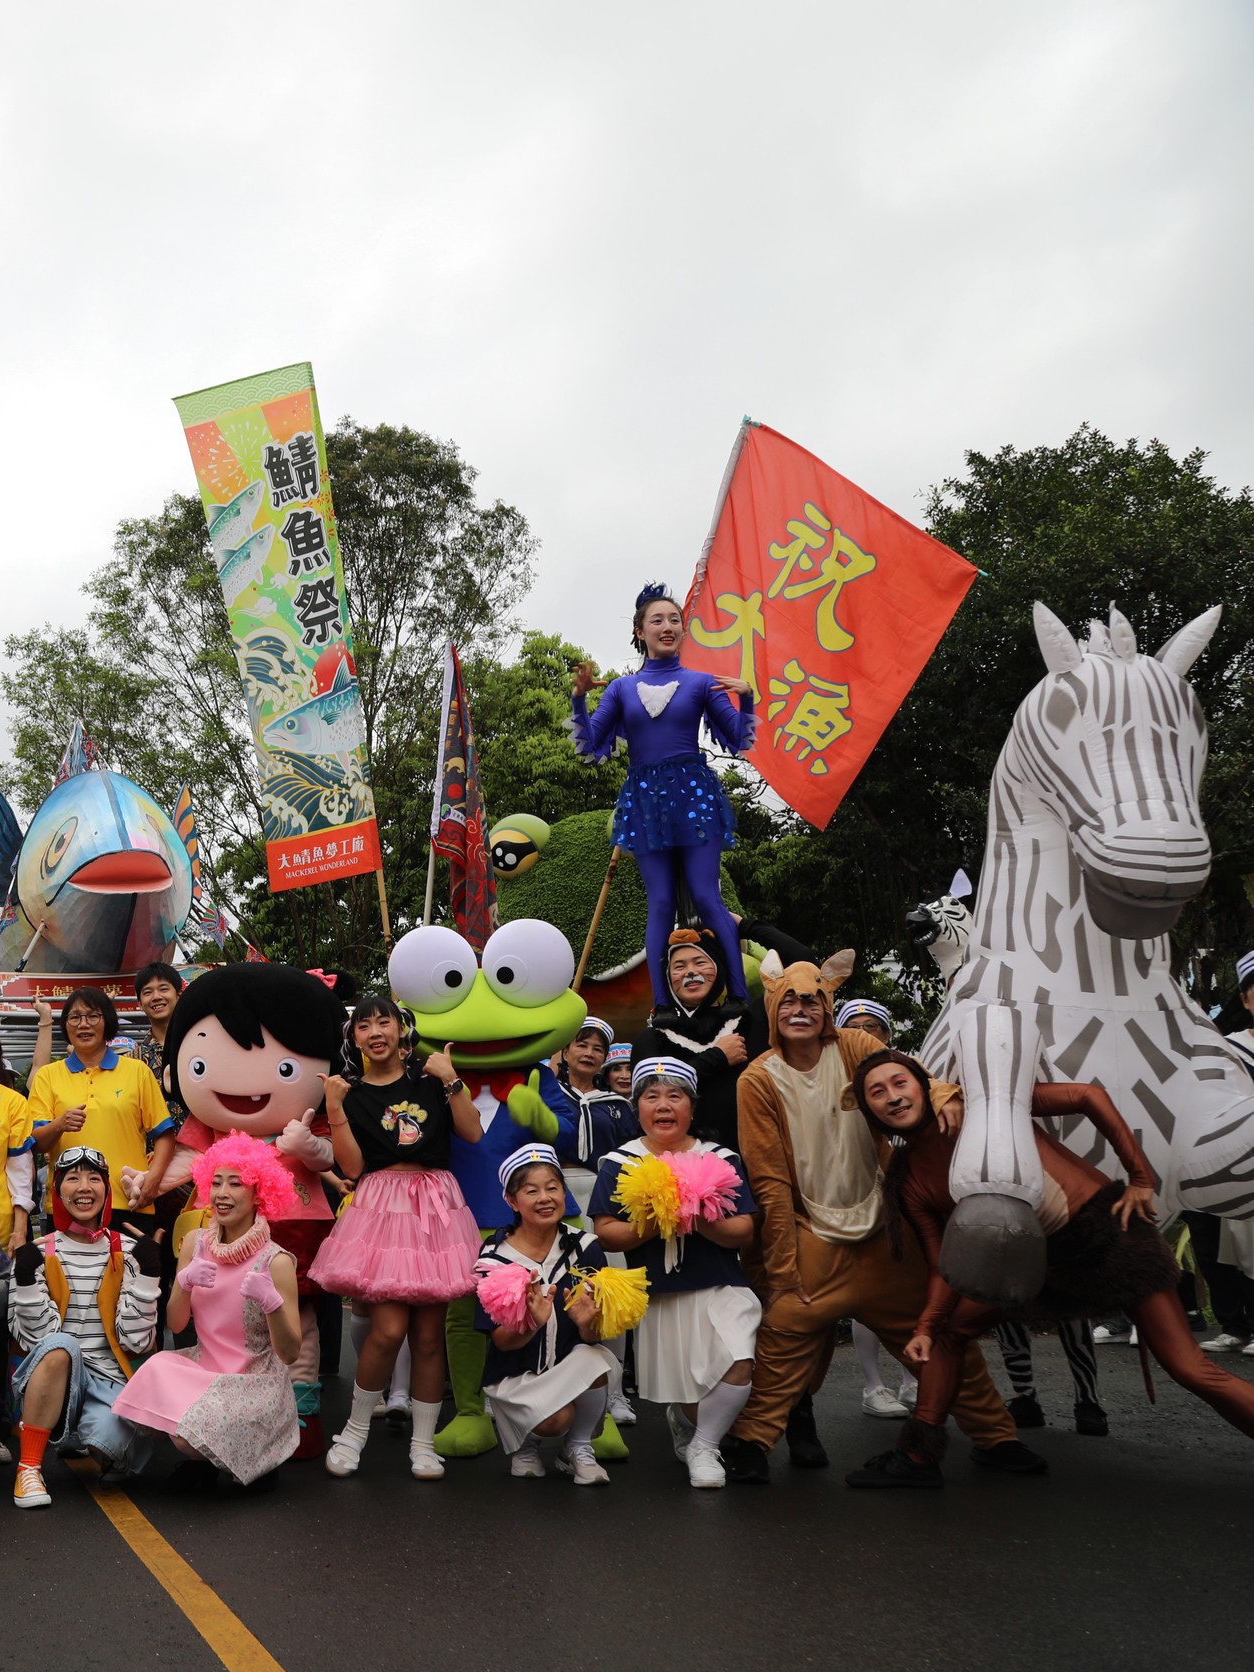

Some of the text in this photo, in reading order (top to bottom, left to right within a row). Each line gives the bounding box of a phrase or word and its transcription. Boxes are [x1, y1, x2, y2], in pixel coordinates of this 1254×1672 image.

[262, 431, 344, 648] 鯖魚祭
[277, 835, 364, 870] 大鯖魚夢工廠
[285, 857, 359, 879] MACKEREL WONDERLAND
